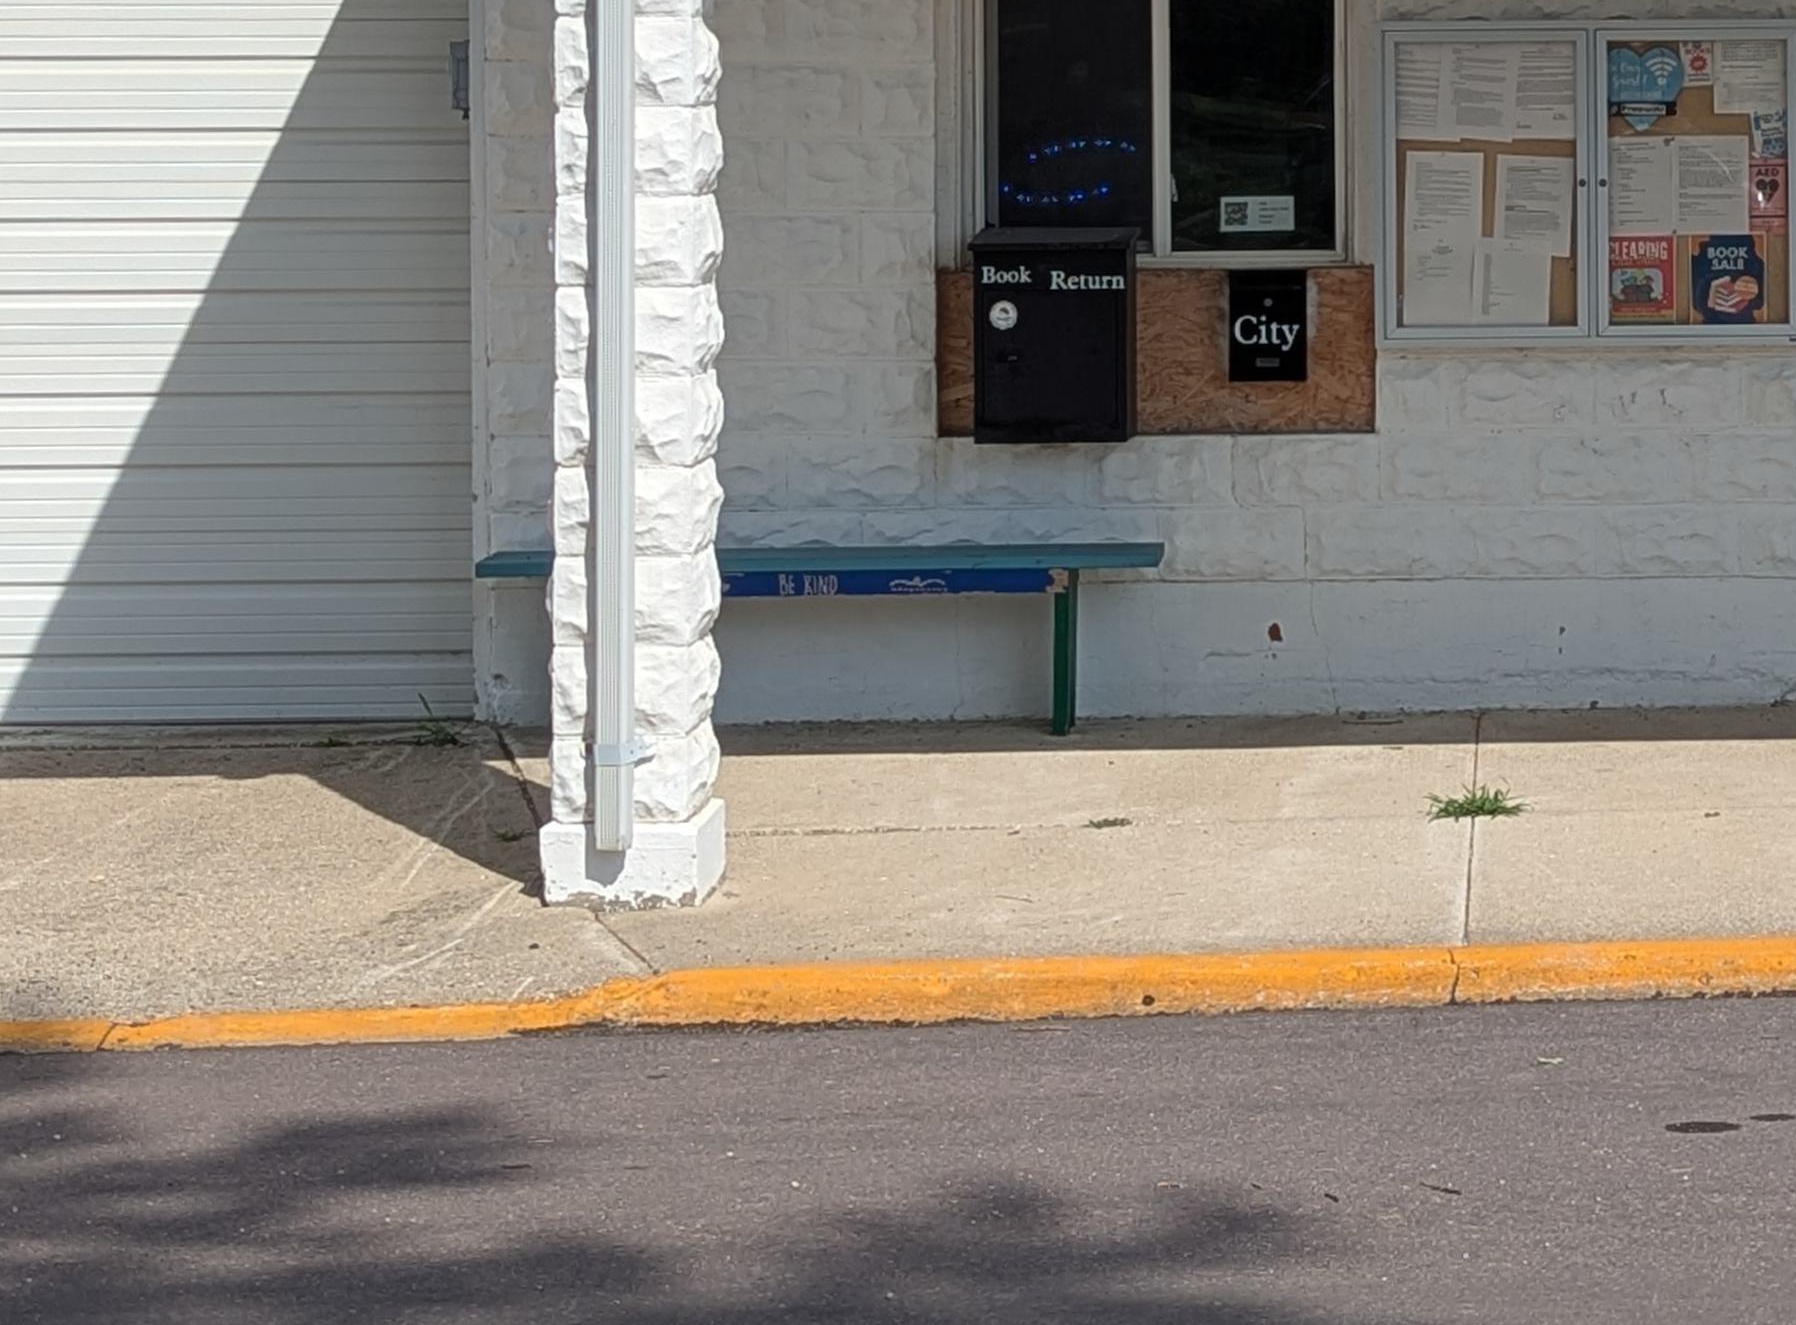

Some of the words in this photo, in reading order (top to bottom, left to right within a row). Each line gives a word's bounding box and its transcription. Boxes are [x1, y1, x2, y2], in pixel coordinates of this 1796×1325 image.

[1756, 167, 1780, 177] AED
[1707, 247, 1748, 259] BOOK
[1711, 258, 1745, 270] SALE
[981, 266, 1032, 284] Book
[1049, 270, 1126, 291] Return
[1233, 315, 1300, 351] City
[778, 574, 795, 595] BE
[803, 574, 839, 596] KIND
